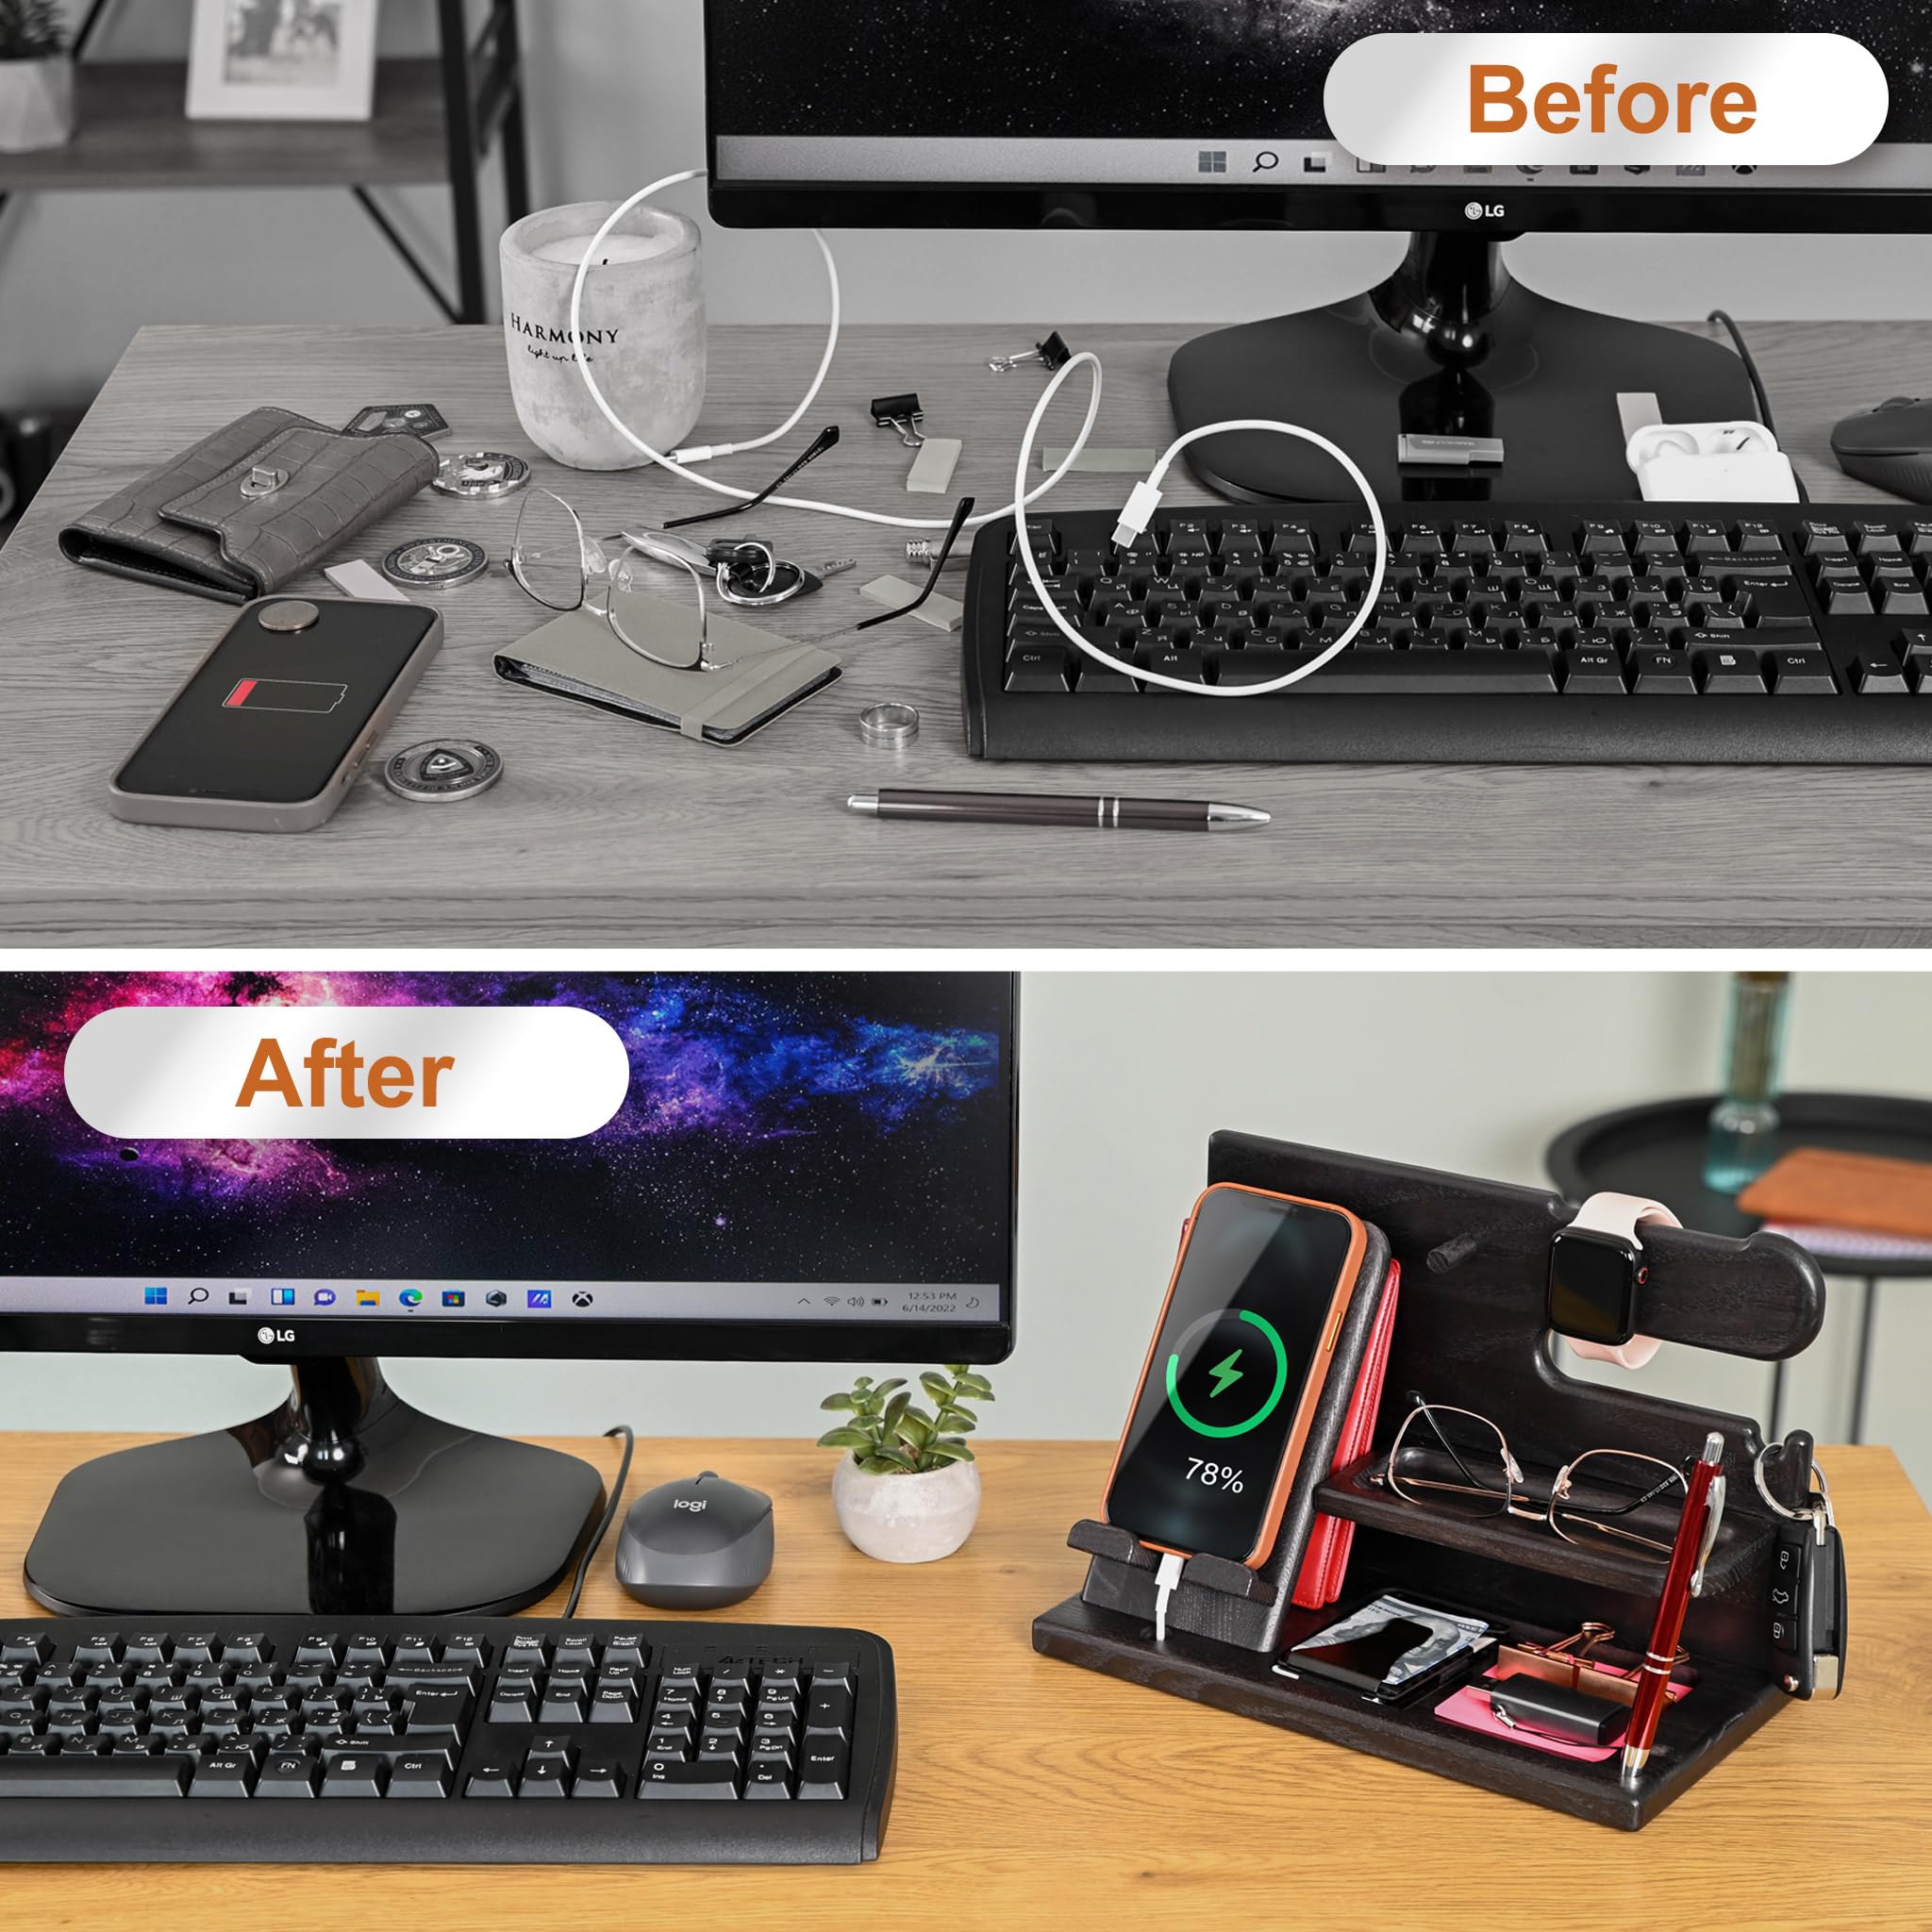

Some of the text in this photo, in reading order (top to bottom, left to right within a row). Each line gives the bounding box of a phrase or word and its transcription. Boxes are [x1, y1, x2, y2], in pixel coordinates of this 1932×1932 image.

[1486, 205, 1504, 217] LG
[908, 1291, 936, 1300] 12:53
[902, 1304, 956, 1313] 6/14/2022
[276, 1330, 294, 1341] LG
[1186, 1457, 1243, 1493] 78%
[674, 1499, 708, 1512] logi
